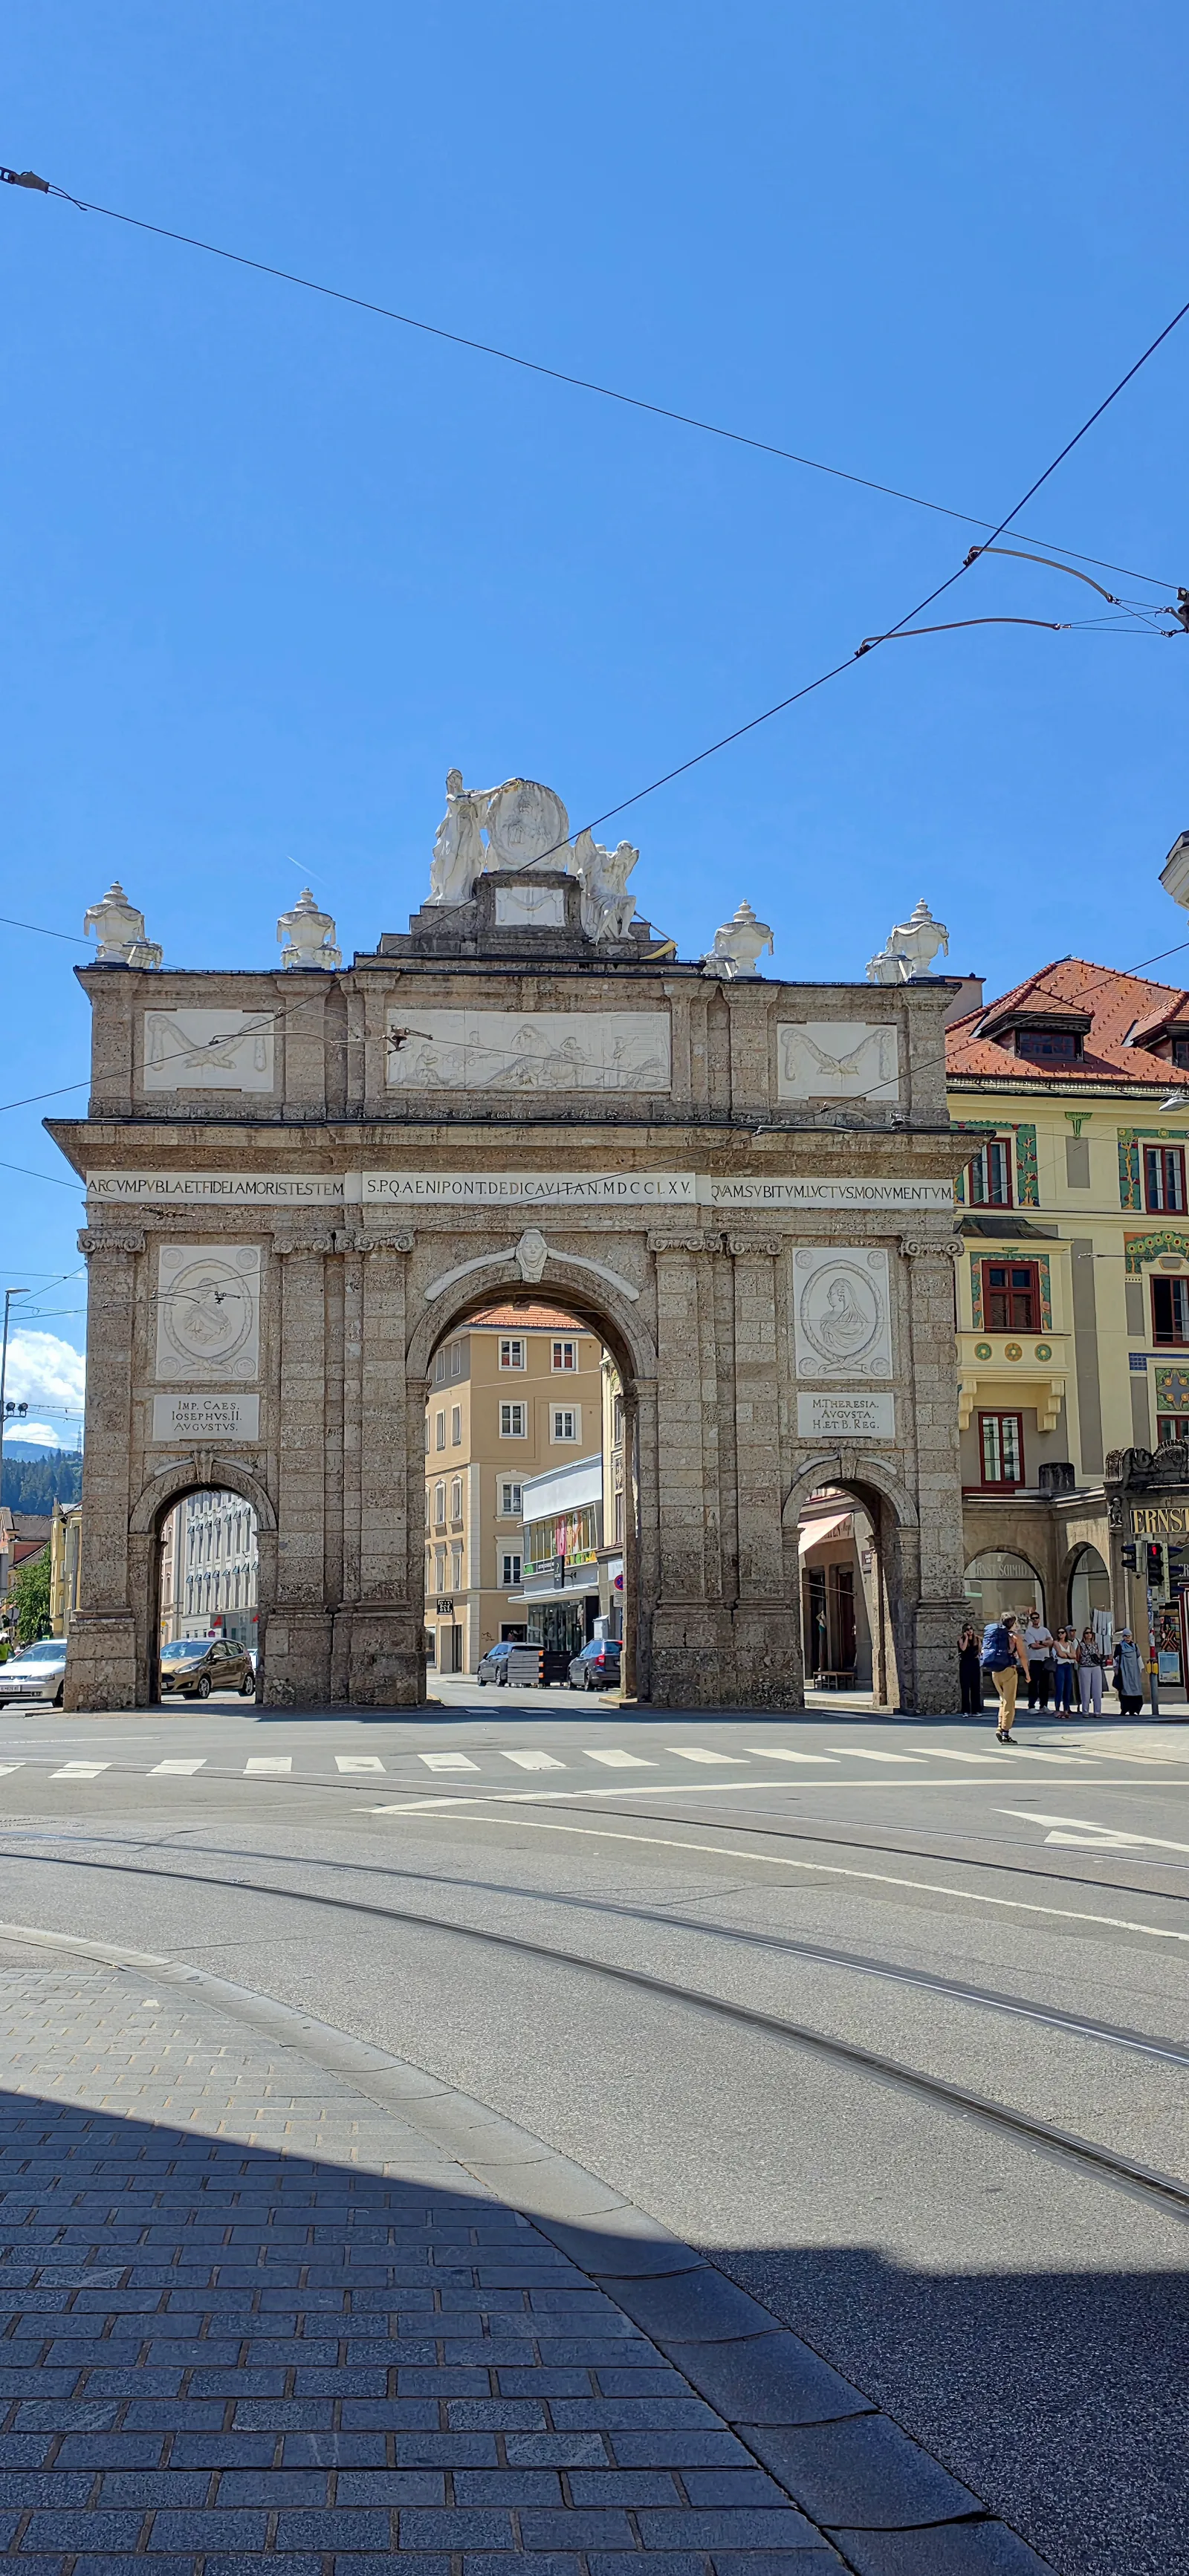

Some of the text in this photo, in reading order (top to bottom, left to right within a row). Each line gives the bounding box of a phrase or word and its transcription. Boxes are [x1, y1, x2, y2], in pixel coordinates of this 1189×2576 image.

[178, 1401, 240, 1410] IMP. CAES.
[821, 1409, 875, 1418] AVGVSTA.
[174, 1422, 239, 1431] AVGVSTVS.
